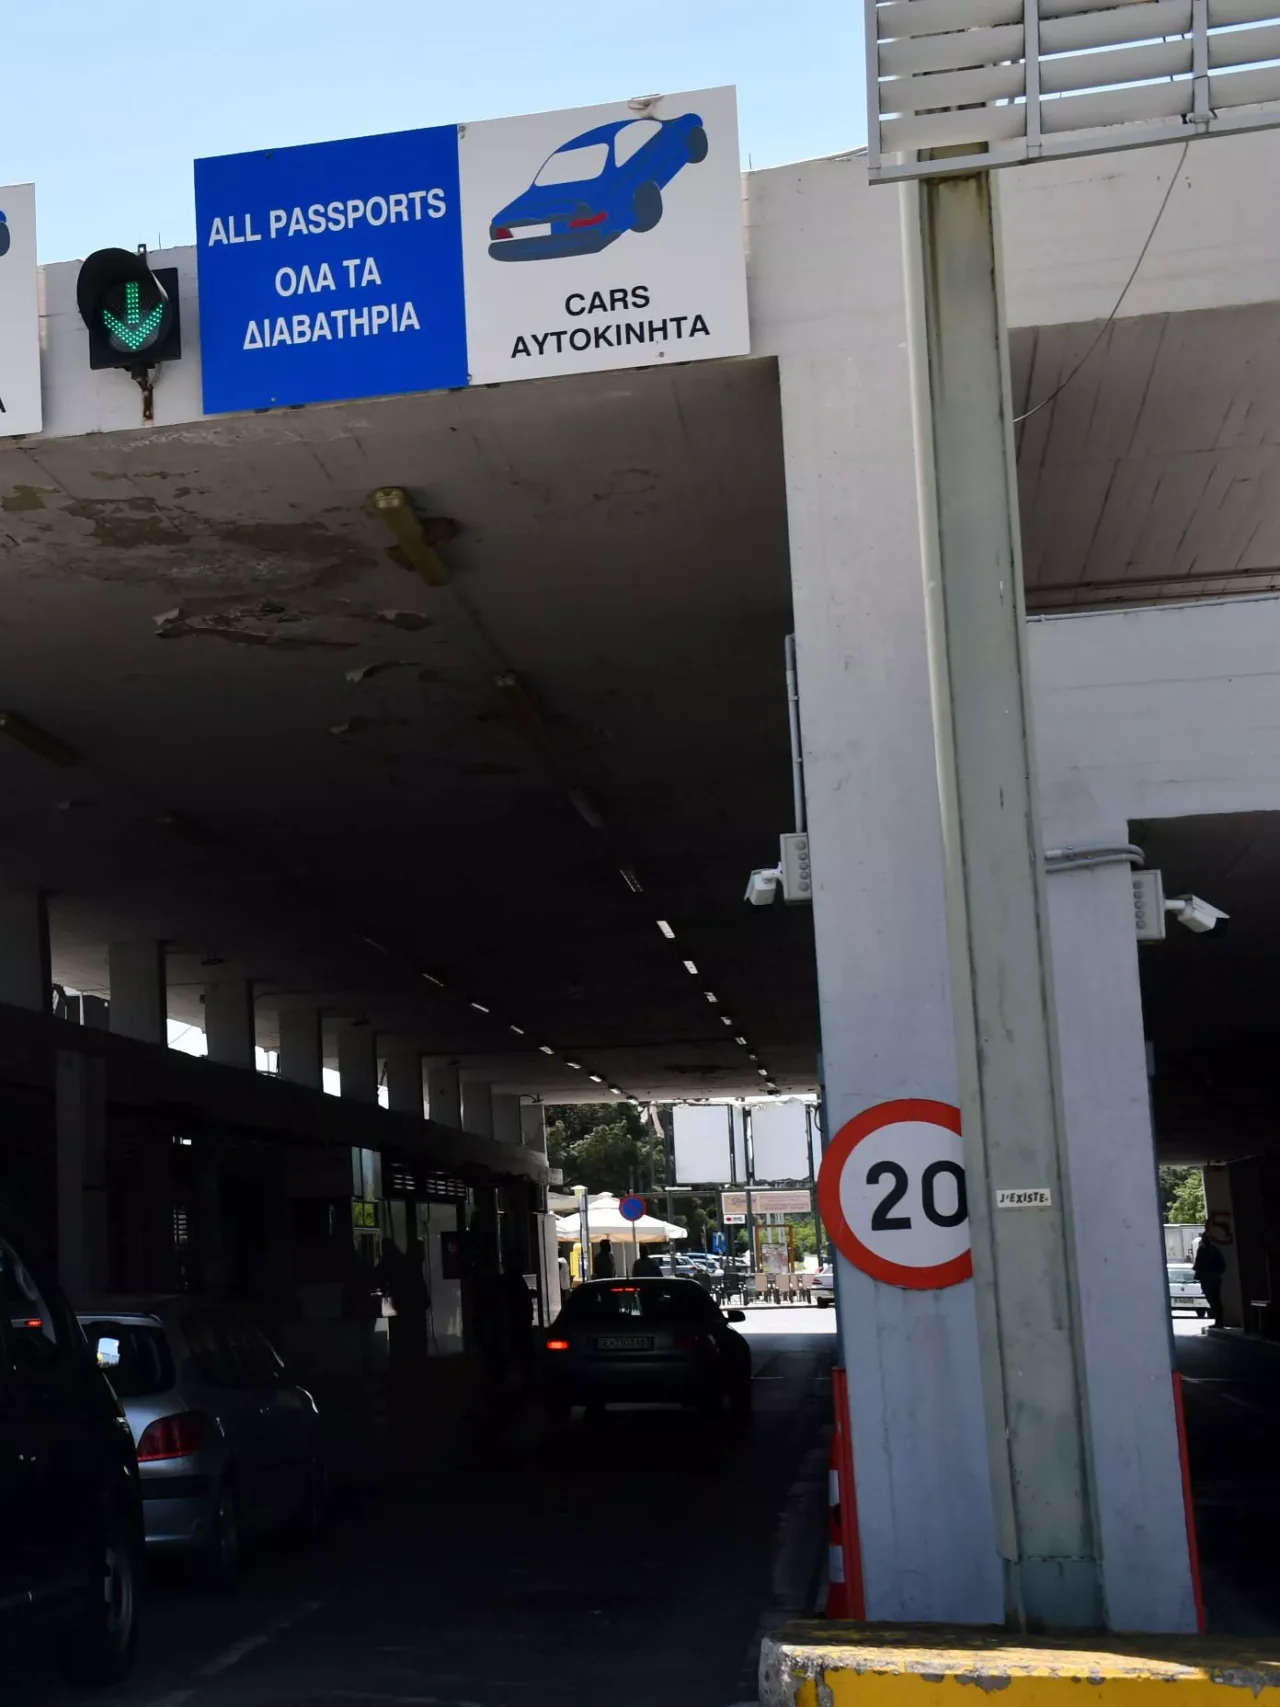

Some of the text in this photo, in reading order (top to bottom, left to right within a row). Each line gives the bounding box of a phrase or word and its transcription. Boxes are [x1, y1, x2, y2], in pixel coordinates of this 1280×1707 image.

[208, 188, 447, 247] ALL PASSPORTS
[274, 257, 382, 298] ΟΛΑ ΤΑ
[564, 285, 651, 316] CARS
[242, 301, 421, 351] ΔΙΑΒΑΤΗΡΙΑ
[510, 314, 711, 359] ΑΥΤΟΚΙΝΗΤΑ
[866, 1160, 968, 1231] 20
